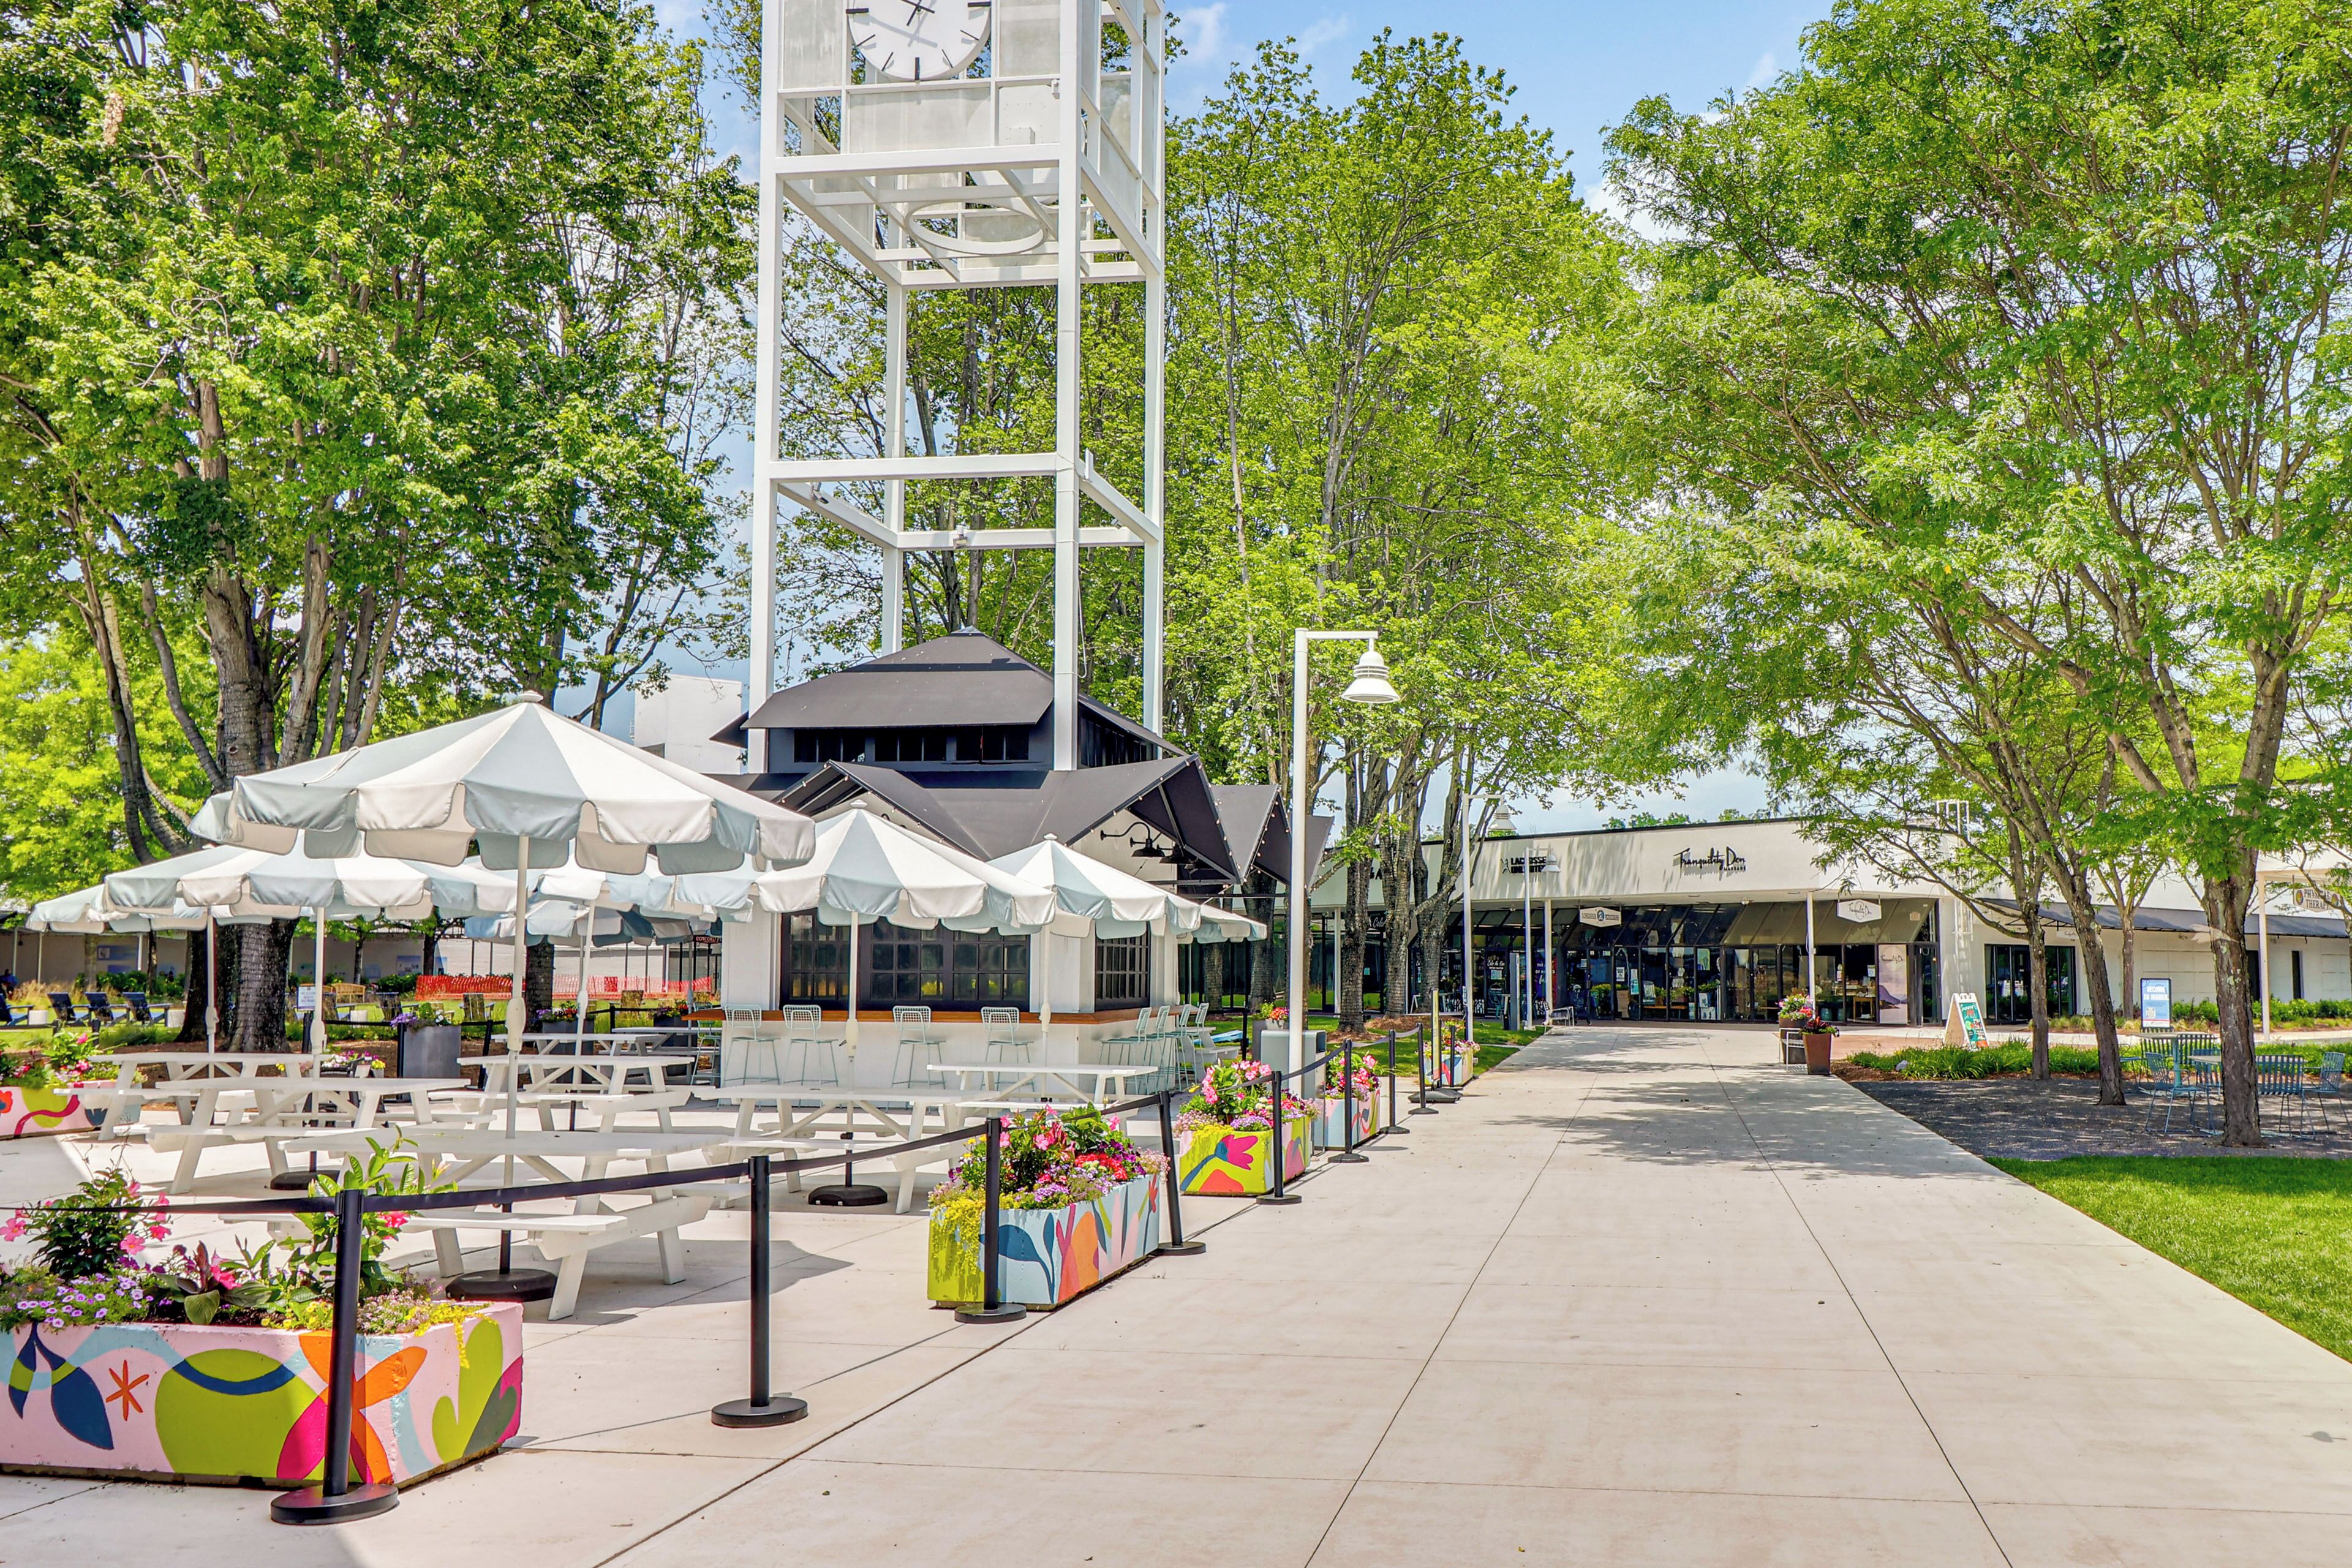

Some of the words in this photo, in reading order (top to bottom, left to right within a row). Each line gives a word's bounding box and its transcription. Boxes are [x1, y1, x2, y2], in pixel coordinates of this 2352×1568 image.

[1510, 856, 1547, 865] LACOSSE
[1673, 847, 1725, 870] Tranquility
[1726, 846, 1746, 866] Den
